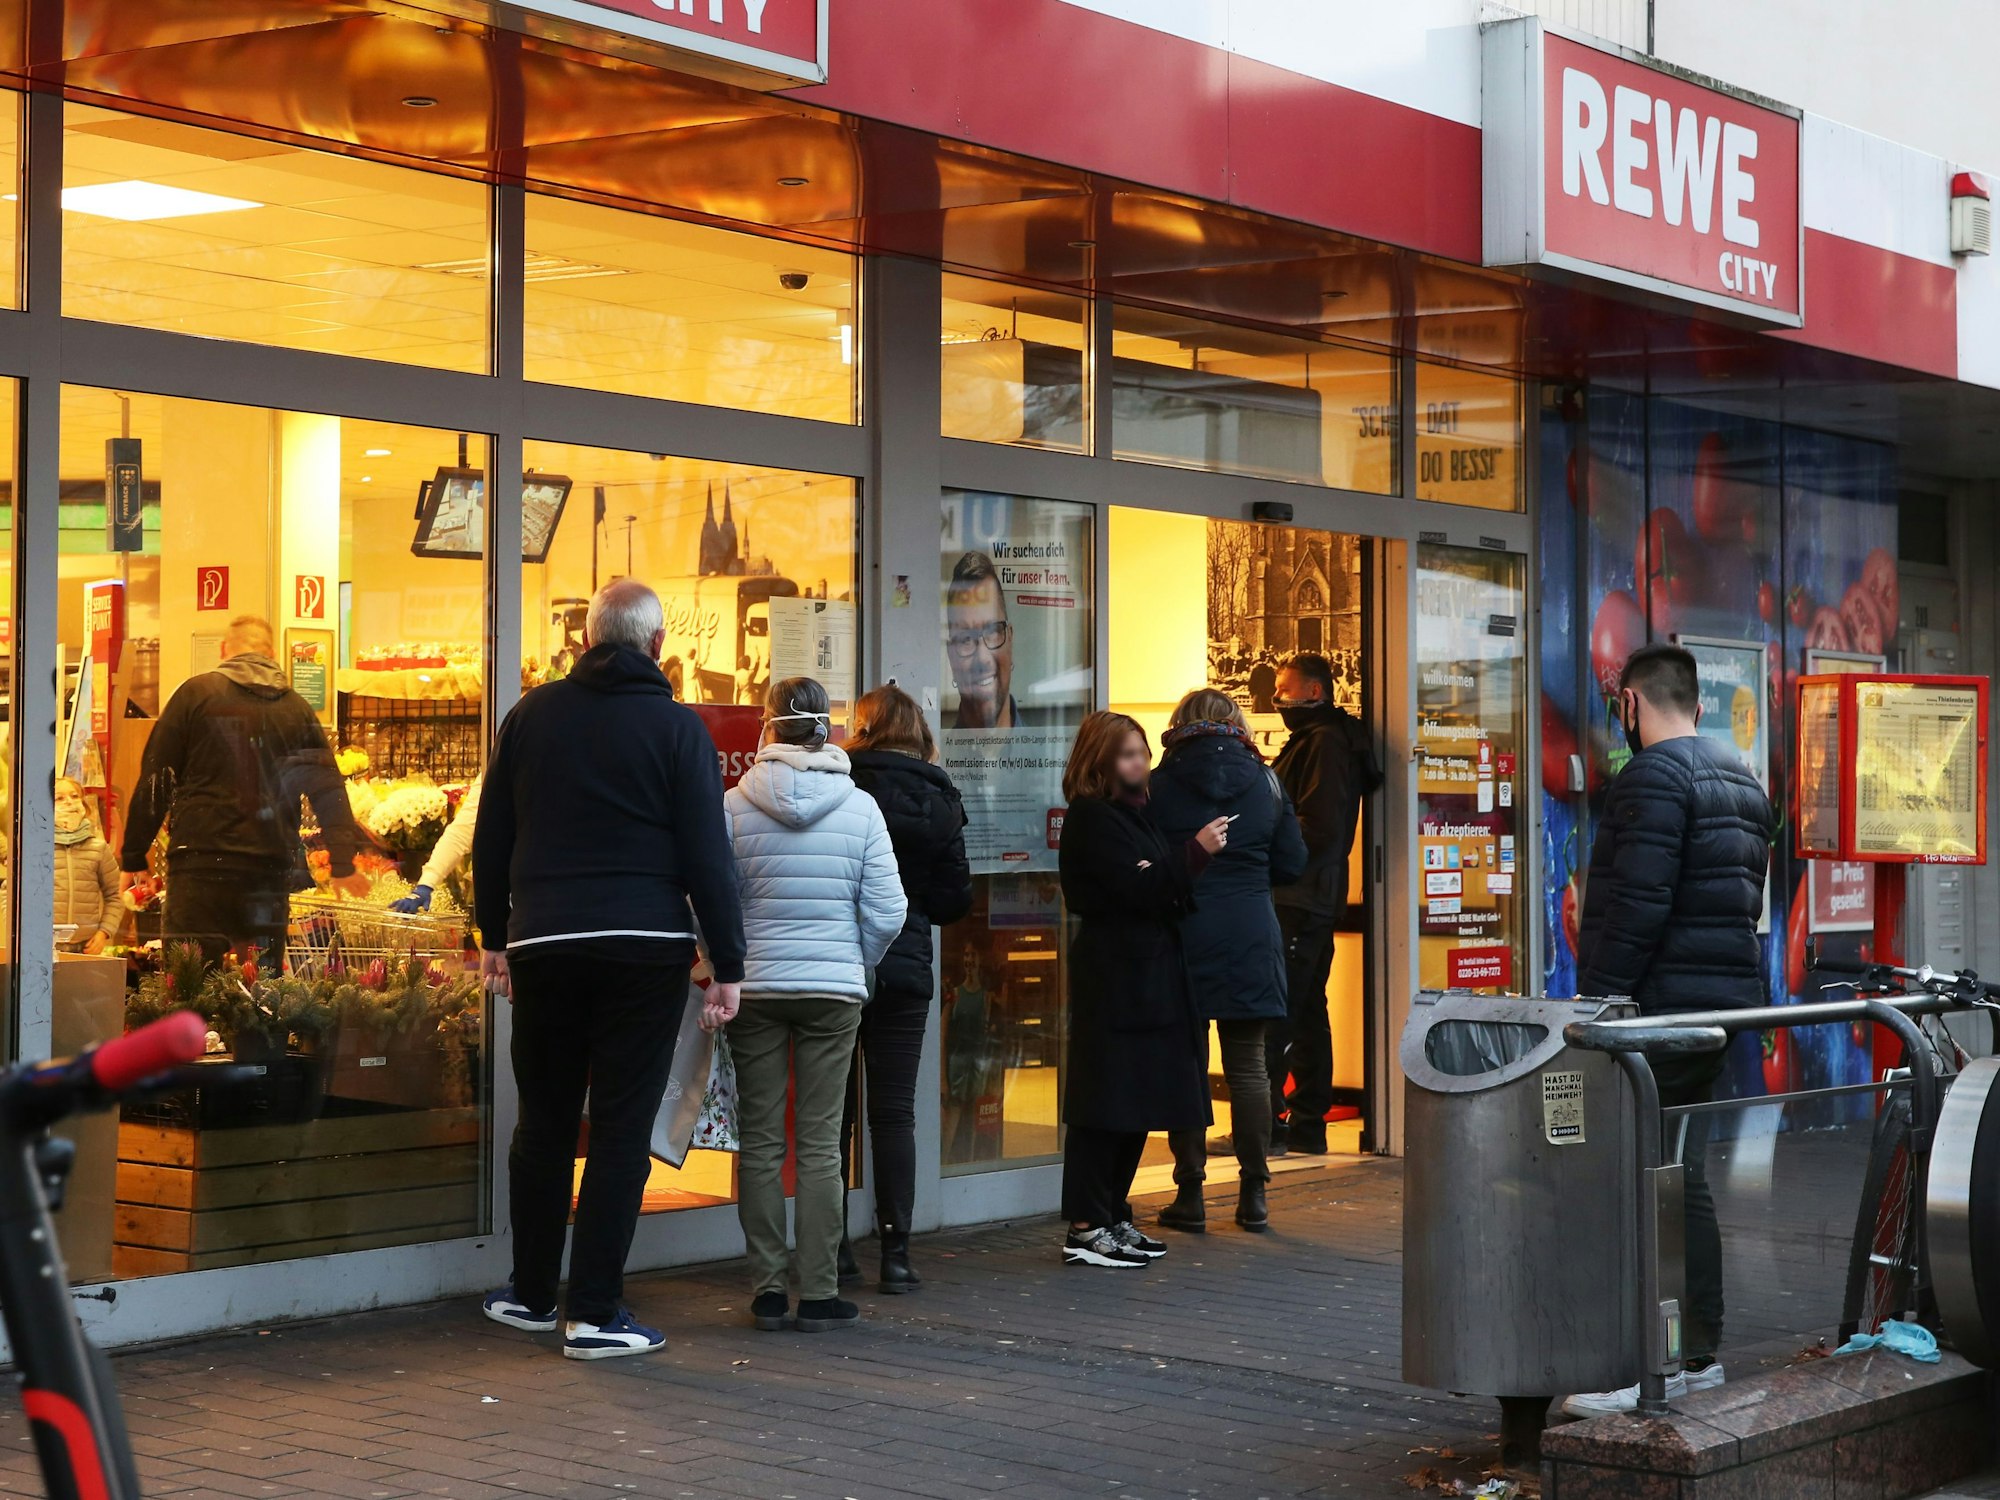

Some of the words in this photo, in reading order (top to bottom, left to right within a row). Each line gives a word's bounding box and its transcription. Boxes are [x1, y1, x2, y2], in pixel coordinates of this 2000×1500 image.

[1562, 66, 1760, 248] REWE
[1718, 252, 1778, 300] CITY
[1427, 401, 1461, 434] DAT
[1421, 450, 1442, 483] DO
[993, 543, 1011, 558] Wir
[1013, 543, 1044, 558] suchen
[1046, 542, 1065, 558] dich
[1001, 568, 1016, 584] für
[1017, 571, 1042, 585] unser
[1044, 569, 1070, 586] Team.
[92, 595, 112, 612] SERVICE
[92, 611, 111, 631] PUNKT
[1423, 669, 1474, 688] willkommen
[1423, 718, 1488, 742] Öffnungszeiten:
[945, 757, 997, 769] Kommissionierer
[998, 758, 1023, 772] (m/w/d)
[1024, 758, 1037, 768] Obst
[1038, 758, 1043, 768] &
[1424, 757, 1444, 768] Montag
[1447, 758, 1468, 769] Samstag
[1423, 822, 1438, 837] Wir
[1440, 821, 1491, 841] akzeptieren:
[1831, 862, 1842, 882] im
[1843, 861, 1865, 881] Preis
[1830, 888, 1866, 917] gesenkt!
[1544, 1075, 1568, 1084] HAST
[1570, 1074, 1582, 1082] DU
[1545, 1084, 1582, 1092] MANCHMAL
[1545, 1091, 1582, 1101] HEIMWEH?
[980, 1103, 998, 1115] REWE
